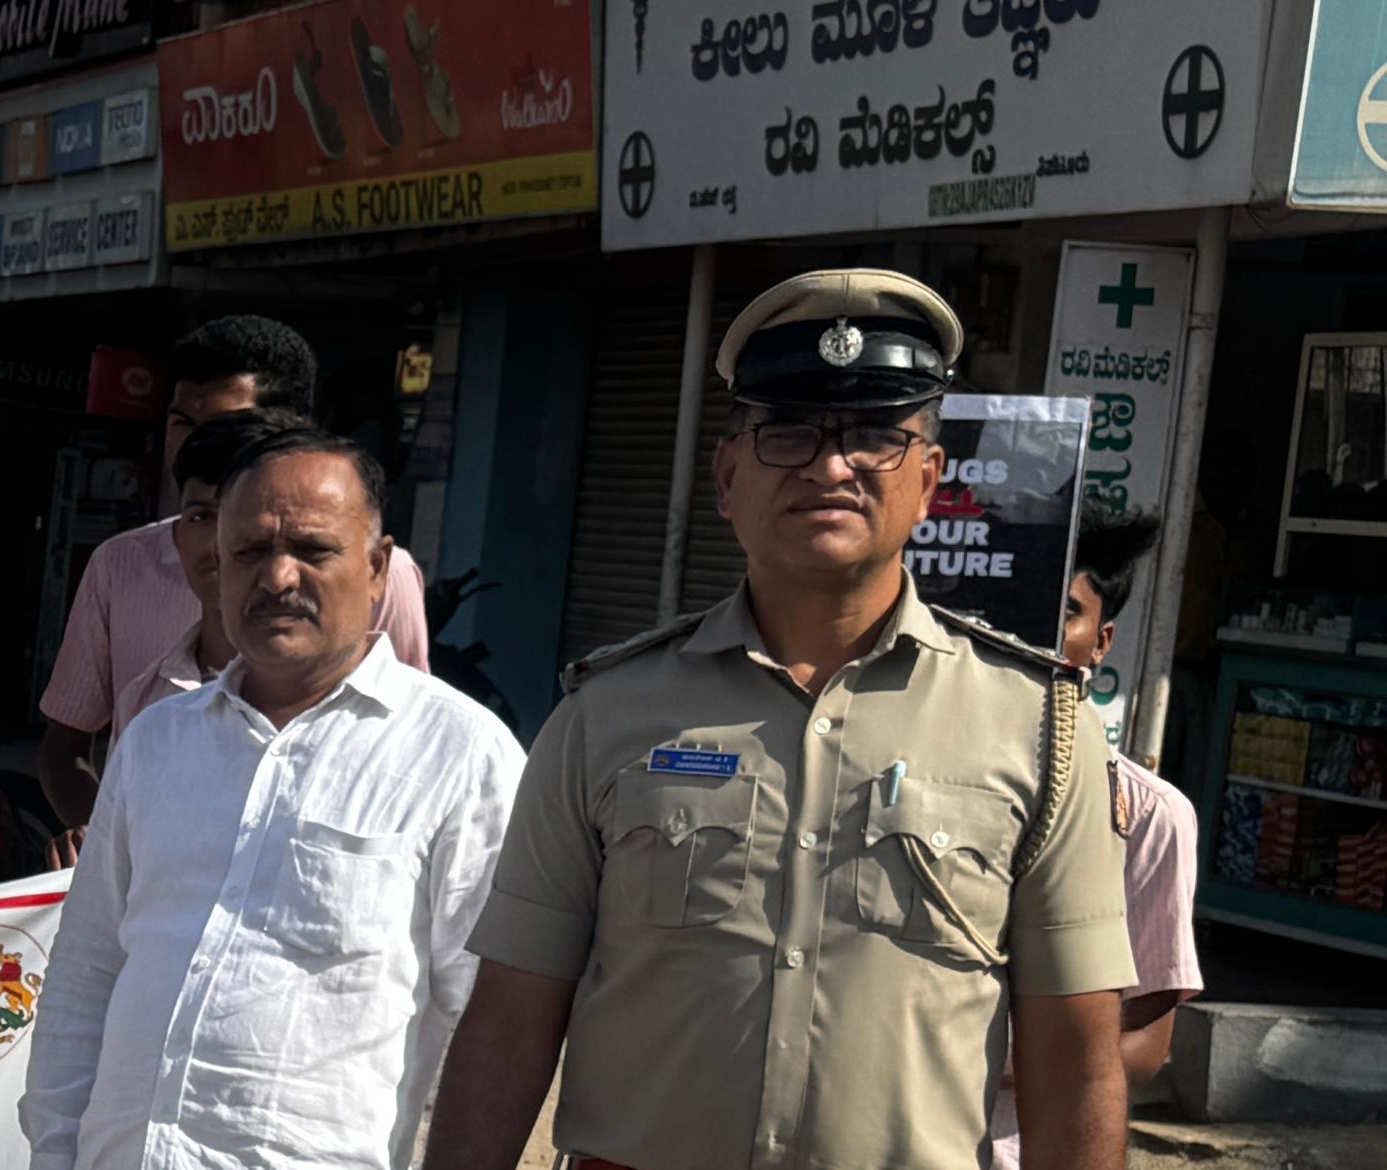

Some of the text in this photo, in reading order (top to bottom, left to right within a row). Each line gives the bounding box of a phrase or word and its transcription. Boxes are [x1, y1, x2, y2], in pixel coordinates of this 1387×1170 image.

[765, 107, 821, 176] ರವಿ
[312, 188, 352, 231] A.S.
[356, 171, 484, 228] FOOTWEAR
[1060, 344, 1091, 377] ರವಿ
[938, 457, 1009, 485] UGS
[911, 519, 991, 547] OUR
[903, 549, 1015, 579] TURE
